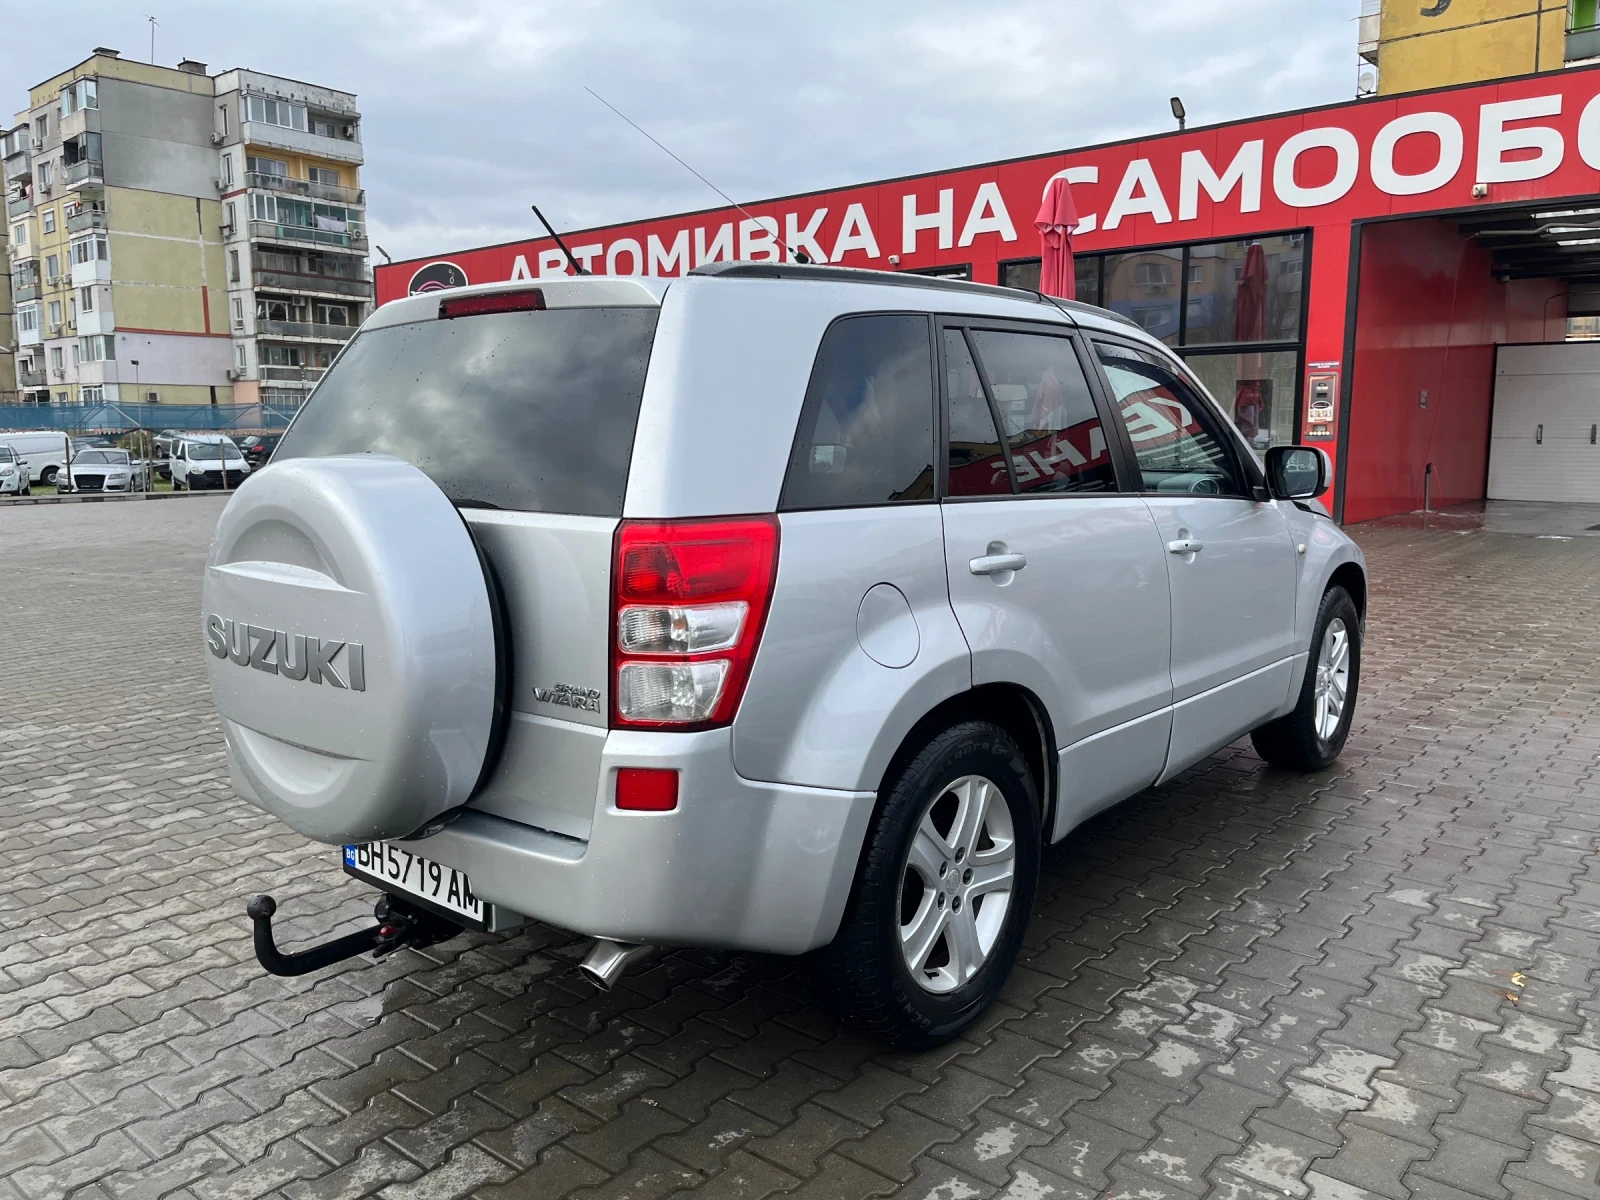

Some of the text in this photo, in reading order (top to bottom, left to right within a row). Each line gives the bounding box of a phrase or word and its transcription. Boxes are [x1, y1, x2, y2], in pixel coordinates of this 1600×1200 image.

[509, 91, 1600, 281] АВТОМИВКА НА САМООБ
[206, 613, 366, 691] SUZUKI
[532, 687, 600, 714] VITARA
[553, 682, 601, 699] GRAND
[346, 848, 355, 861] BG
